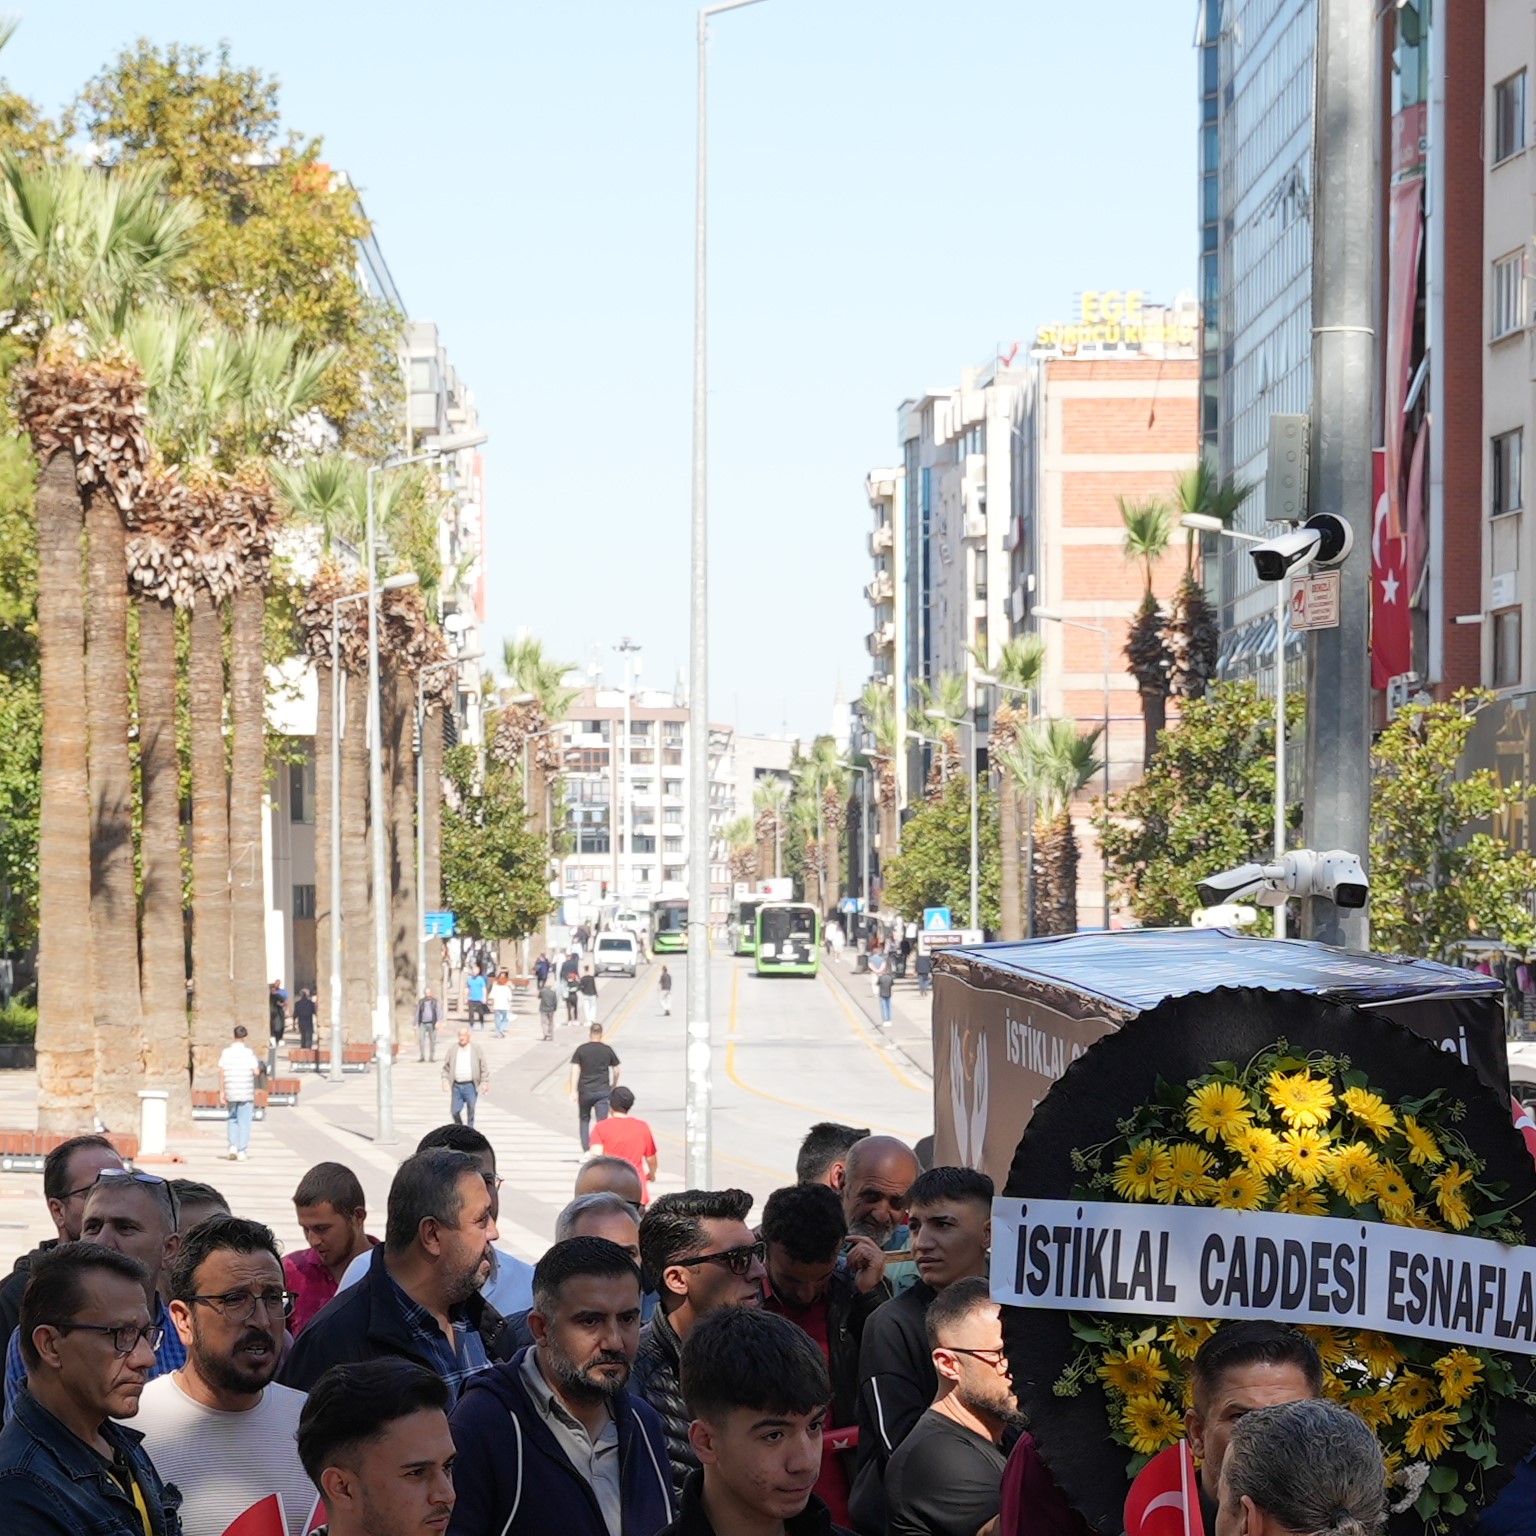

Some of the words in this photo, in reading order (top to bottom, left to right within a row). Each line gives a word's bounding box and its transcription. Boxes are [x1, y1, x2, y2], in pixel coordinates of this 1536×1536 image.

[1081, 290, 1144, 321] EGE
[1014, 1203, 1177, 1303] İSTİKLAL
[1199, 1226, 1369, 1316] CADDESİ
